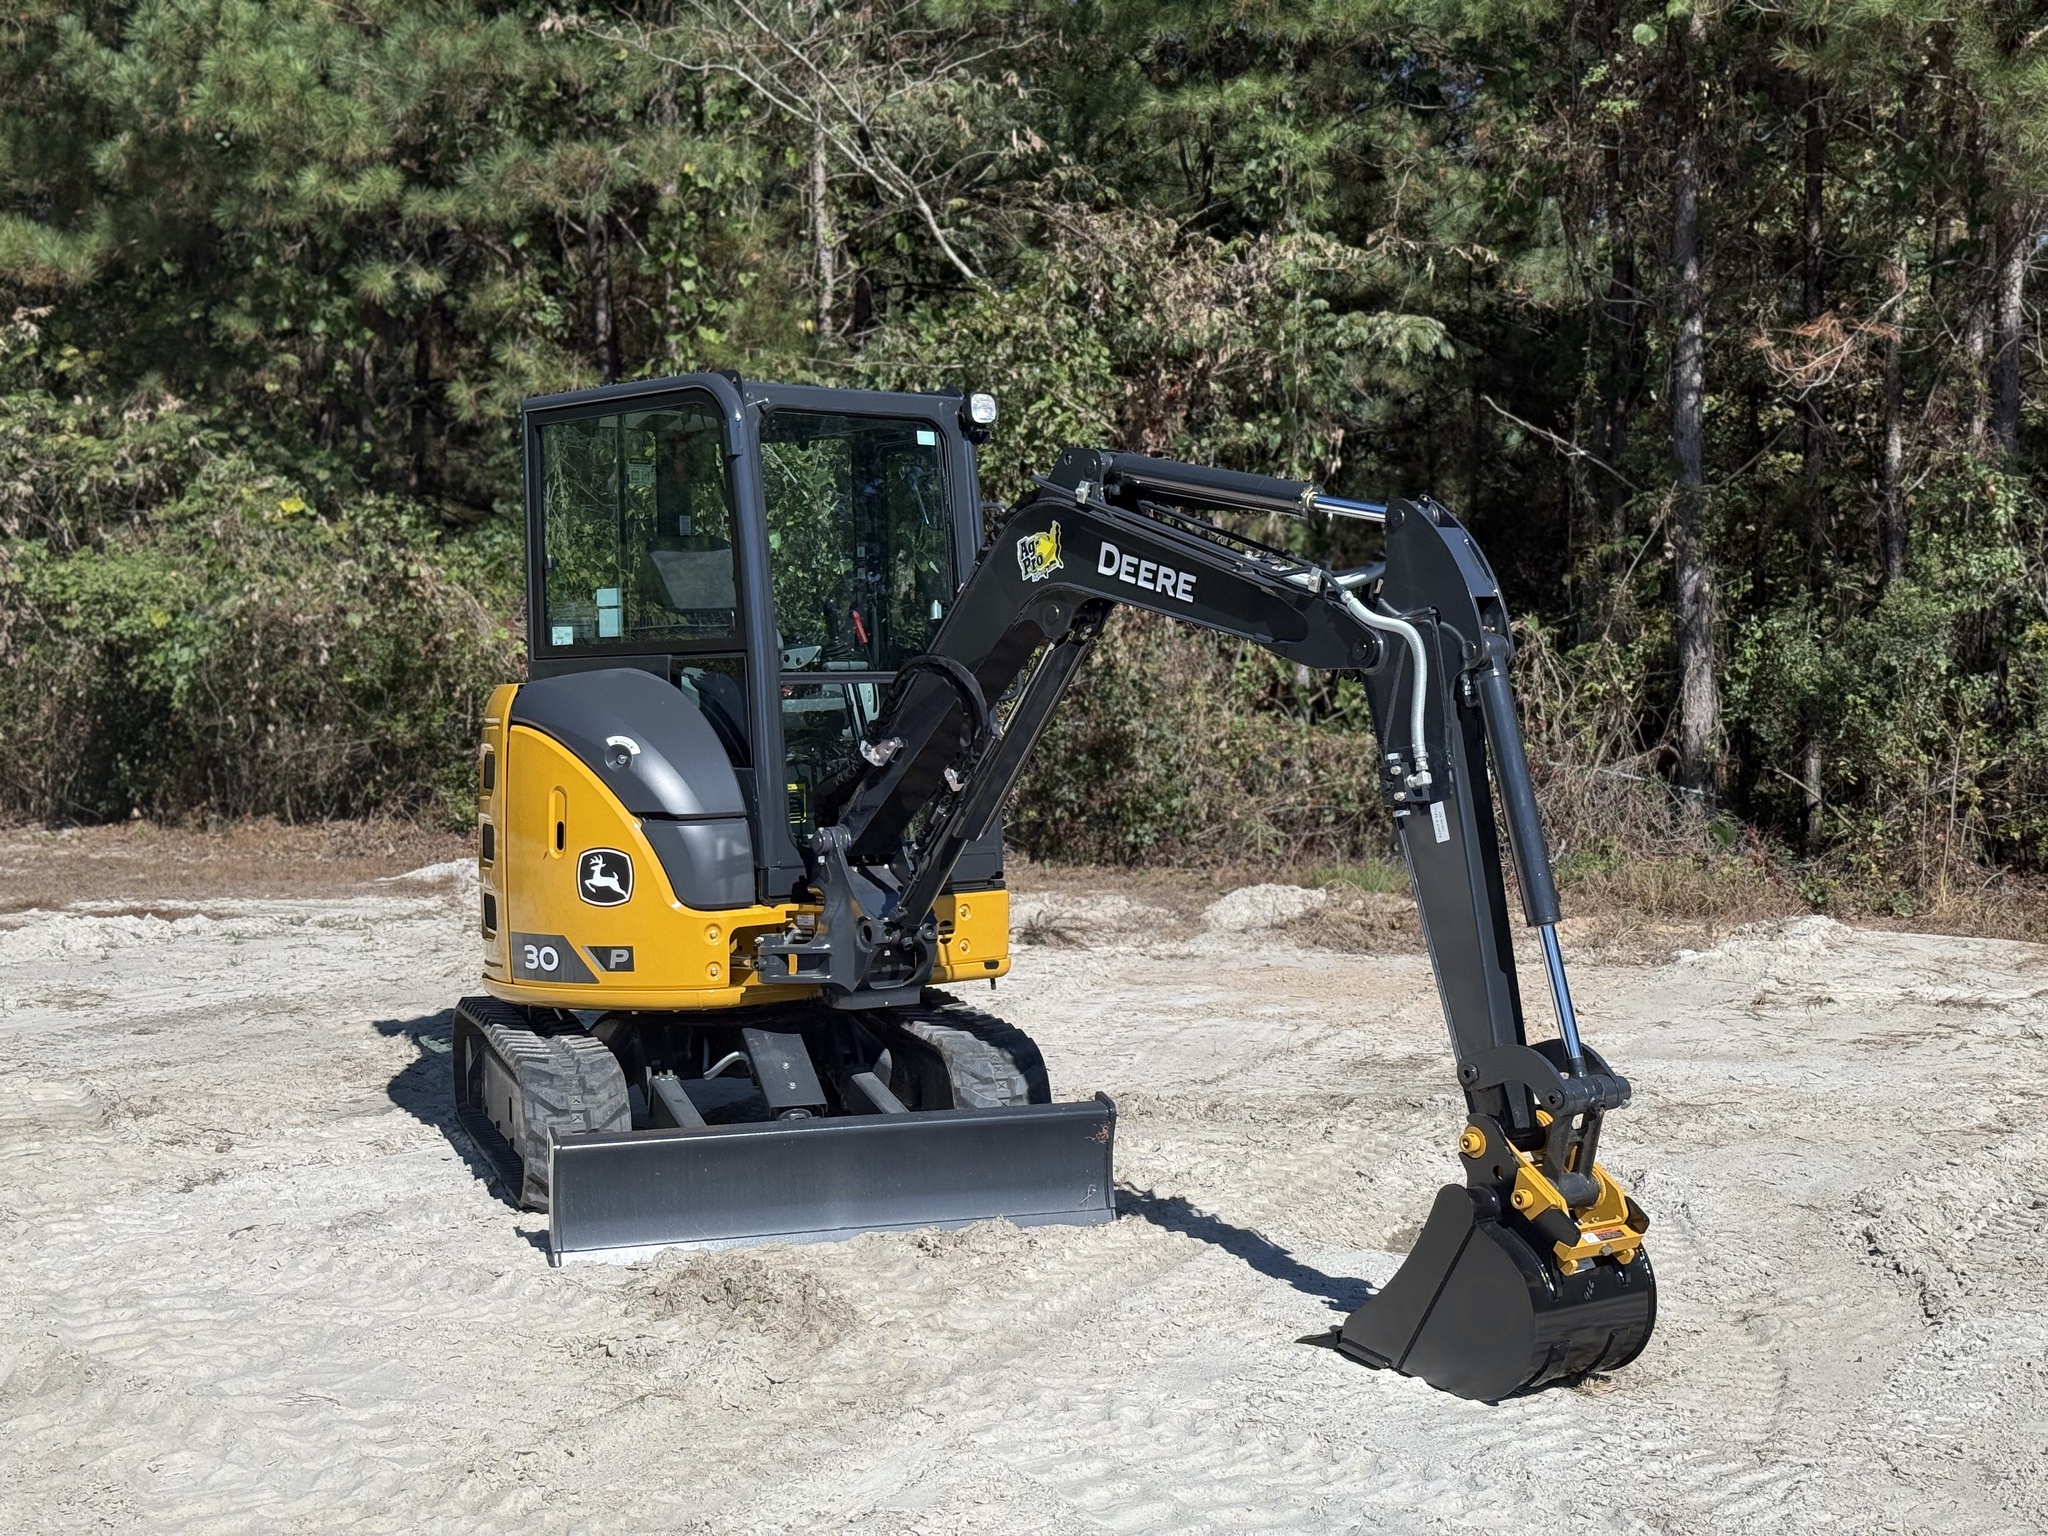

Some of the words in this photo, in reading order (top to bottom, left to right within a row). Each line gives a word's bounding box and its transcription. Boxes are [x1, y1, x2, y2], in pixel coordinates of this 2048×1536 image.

[1022, 554, 1044, 576] Pro
[1097, 541, 1197, 603] DEERE
[523, 944, 559, 972] 30
[609, 949, 631, 969] P
